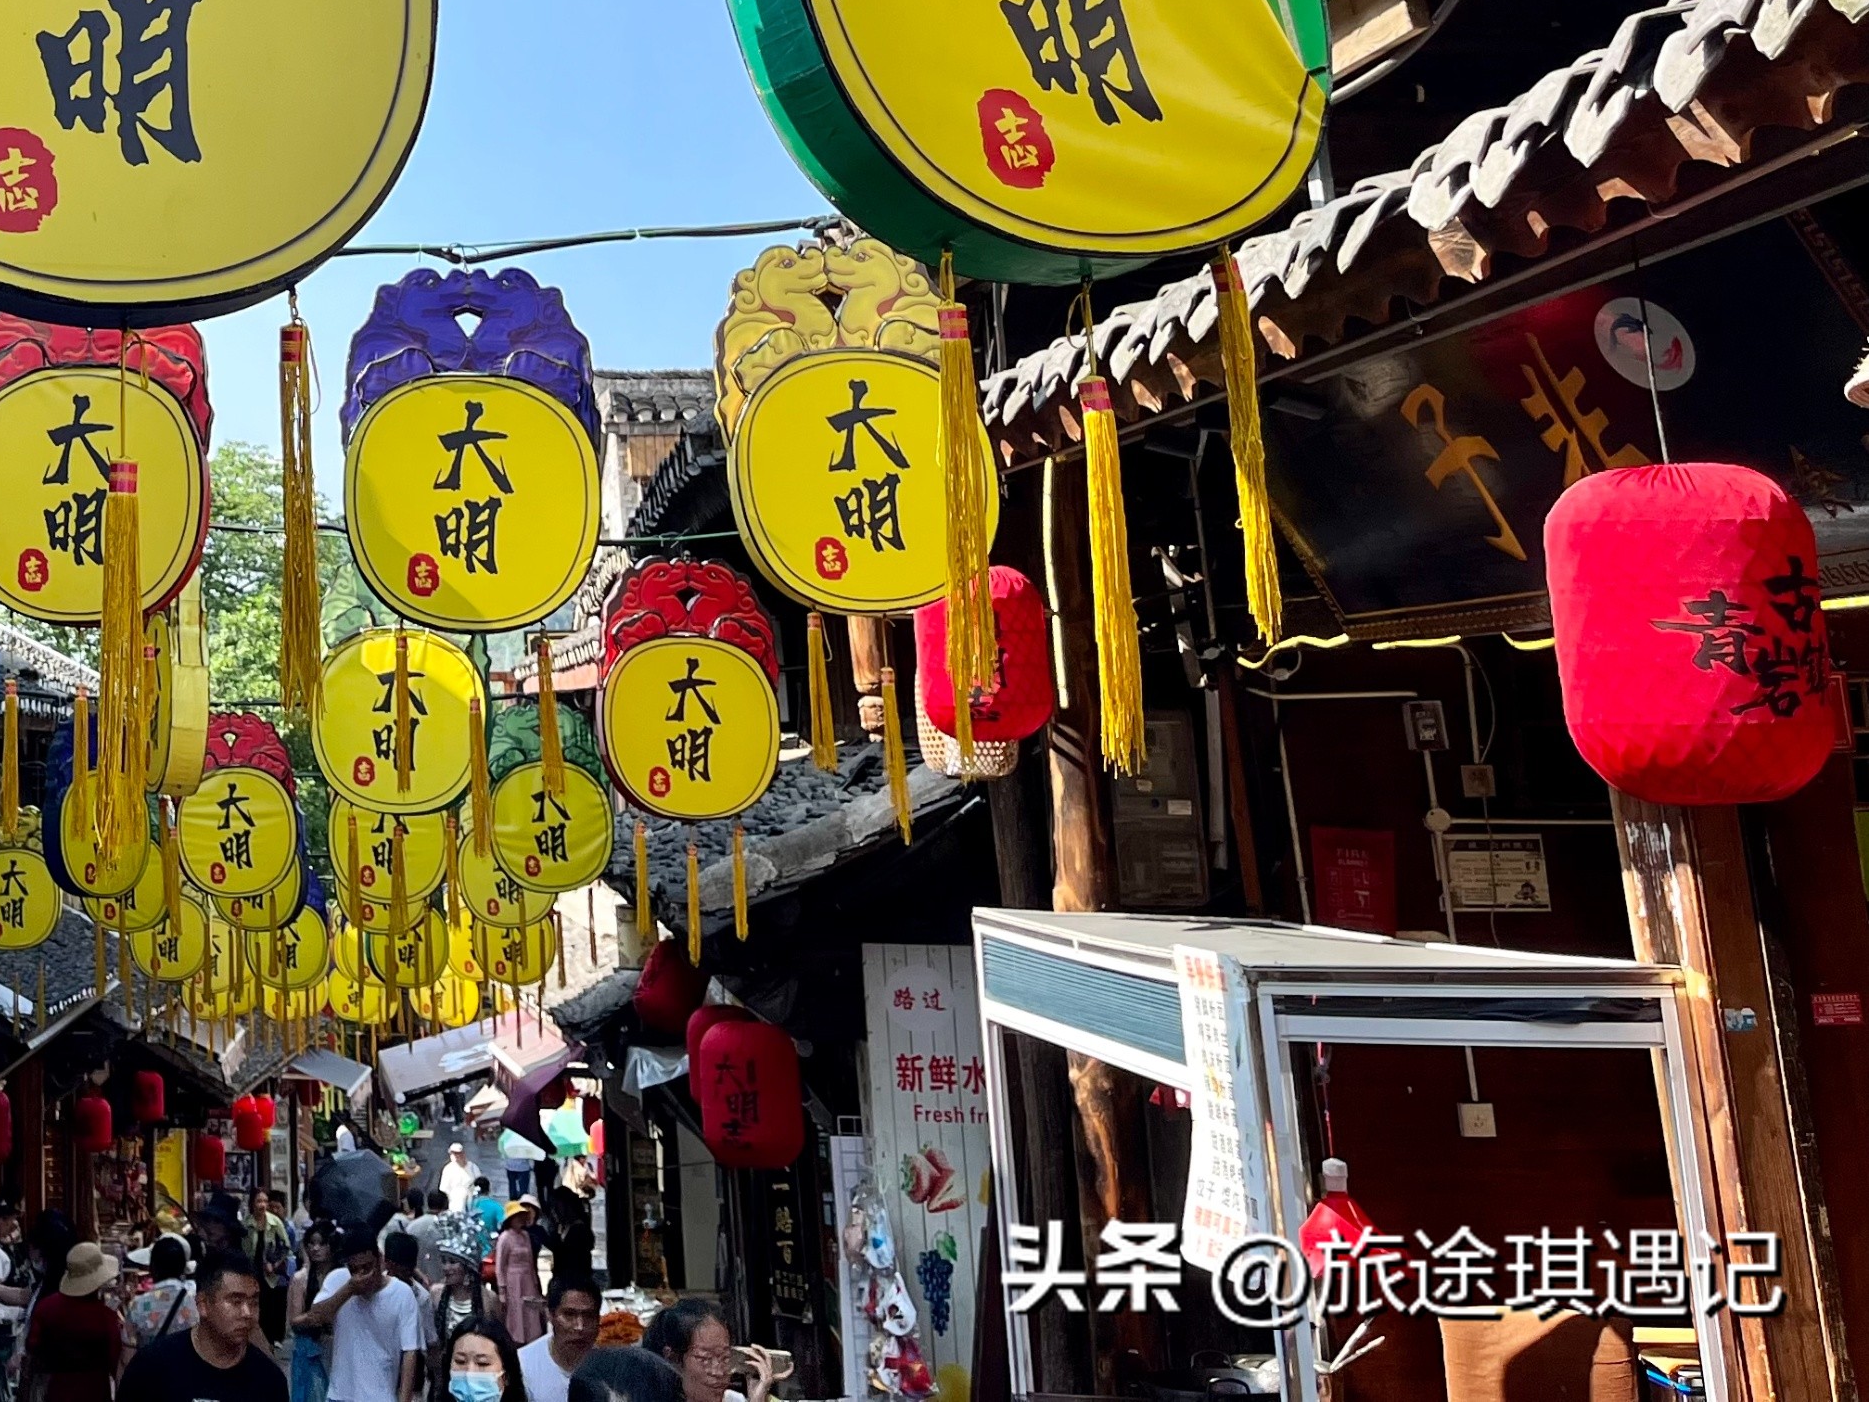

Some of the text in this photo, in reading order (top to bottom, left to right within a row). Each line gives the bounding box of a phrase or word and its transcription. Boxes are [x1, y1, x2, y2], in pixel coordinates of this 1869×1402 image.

[42, 395, 114, 566] 大明
[434, 401, 514, 575] 大明
[825, 379, 910, 552] 大明
[665, 658, 722, 782] 大明
[216, 783, 256, 869] 大明
[0, 859, 29, 929] 大明
[893, 986, 947, 1011] 路过
[896, 1053, 986, 1095] 新鲜水
[914, 1104, 965, 1124] Fresh
